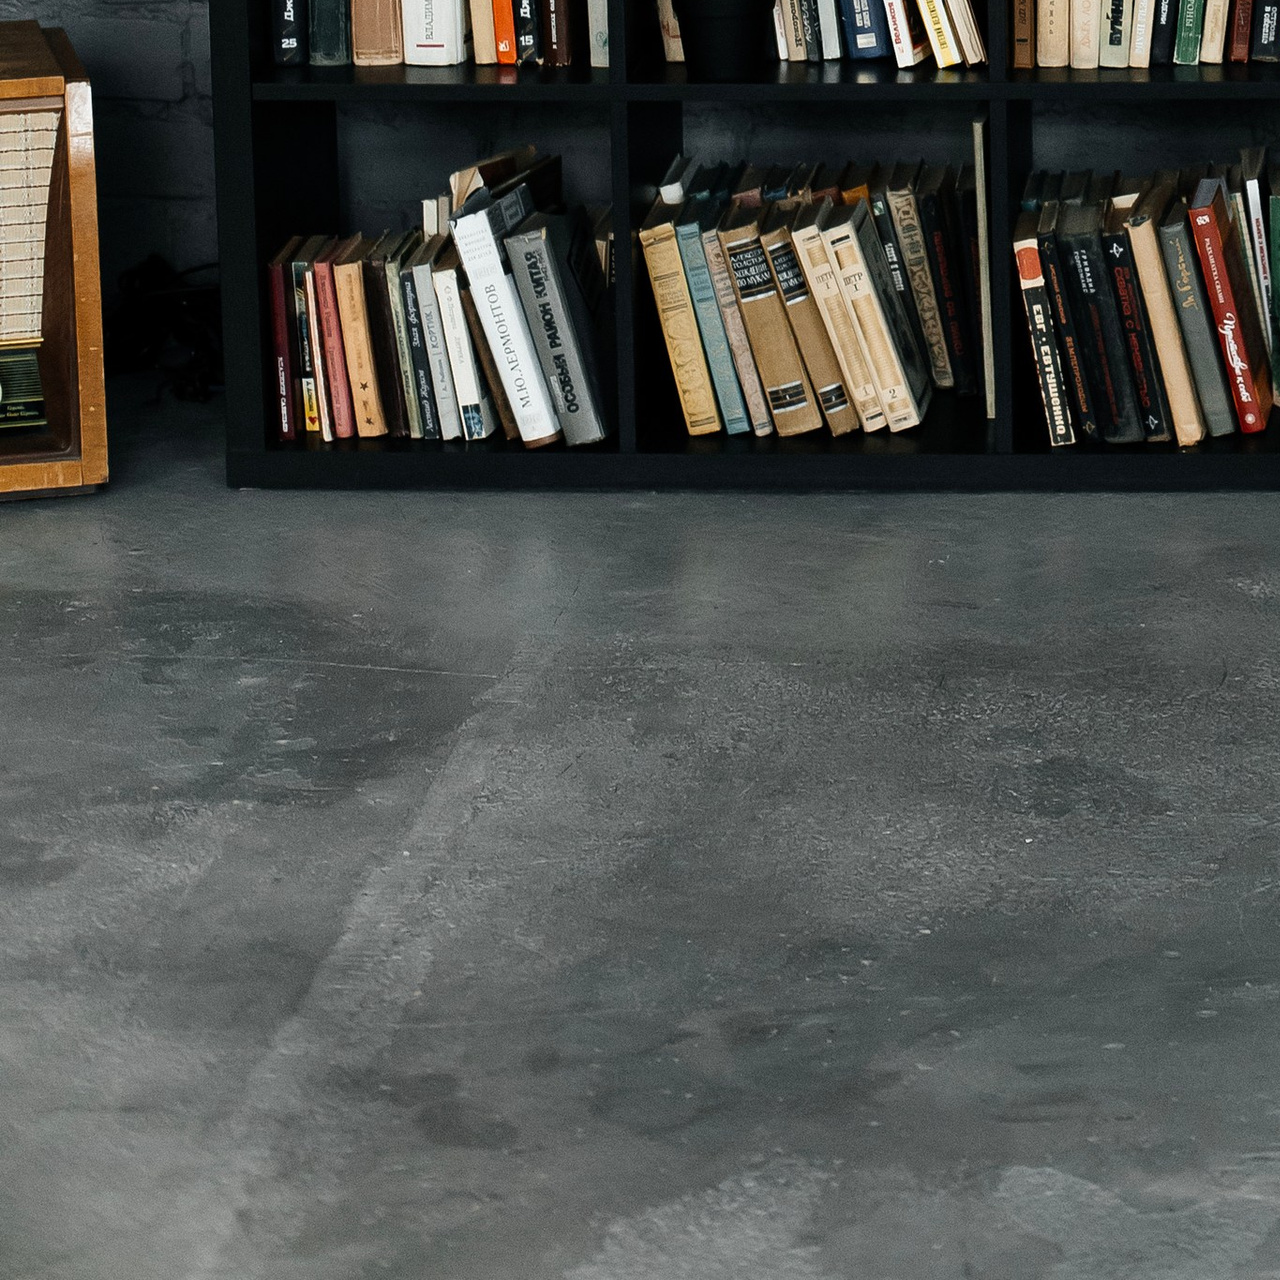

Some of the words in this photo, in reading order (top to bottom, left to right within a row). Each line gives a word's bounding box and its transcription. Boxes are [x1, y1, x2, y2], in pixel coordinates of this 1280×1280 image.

[281, 37, 298, 50] 25
[885, 0, 903, 46] Великая
[1080, 19, 1092, 50] ДЖЕК
[523, 250, 548, 299] КИТАЯ
[1112, 265, 1132, 317] СХВАТКА
[1203, 236, 1220, 281] РАДХАНАТХА
[1213, 280, 1225, 304] СВАМИ
[424, 310, 440, 350] КОРТИК
[539, 302, 564, 350] РАЙОН
[553, 353, 580, 415] ОСОБЫЙ
[1040, 344, 1066, 436] ЕВТУШЕНКО
[1063, 334, 1090, 414] ЗЕМЛЕПРОХОДЦЫ
